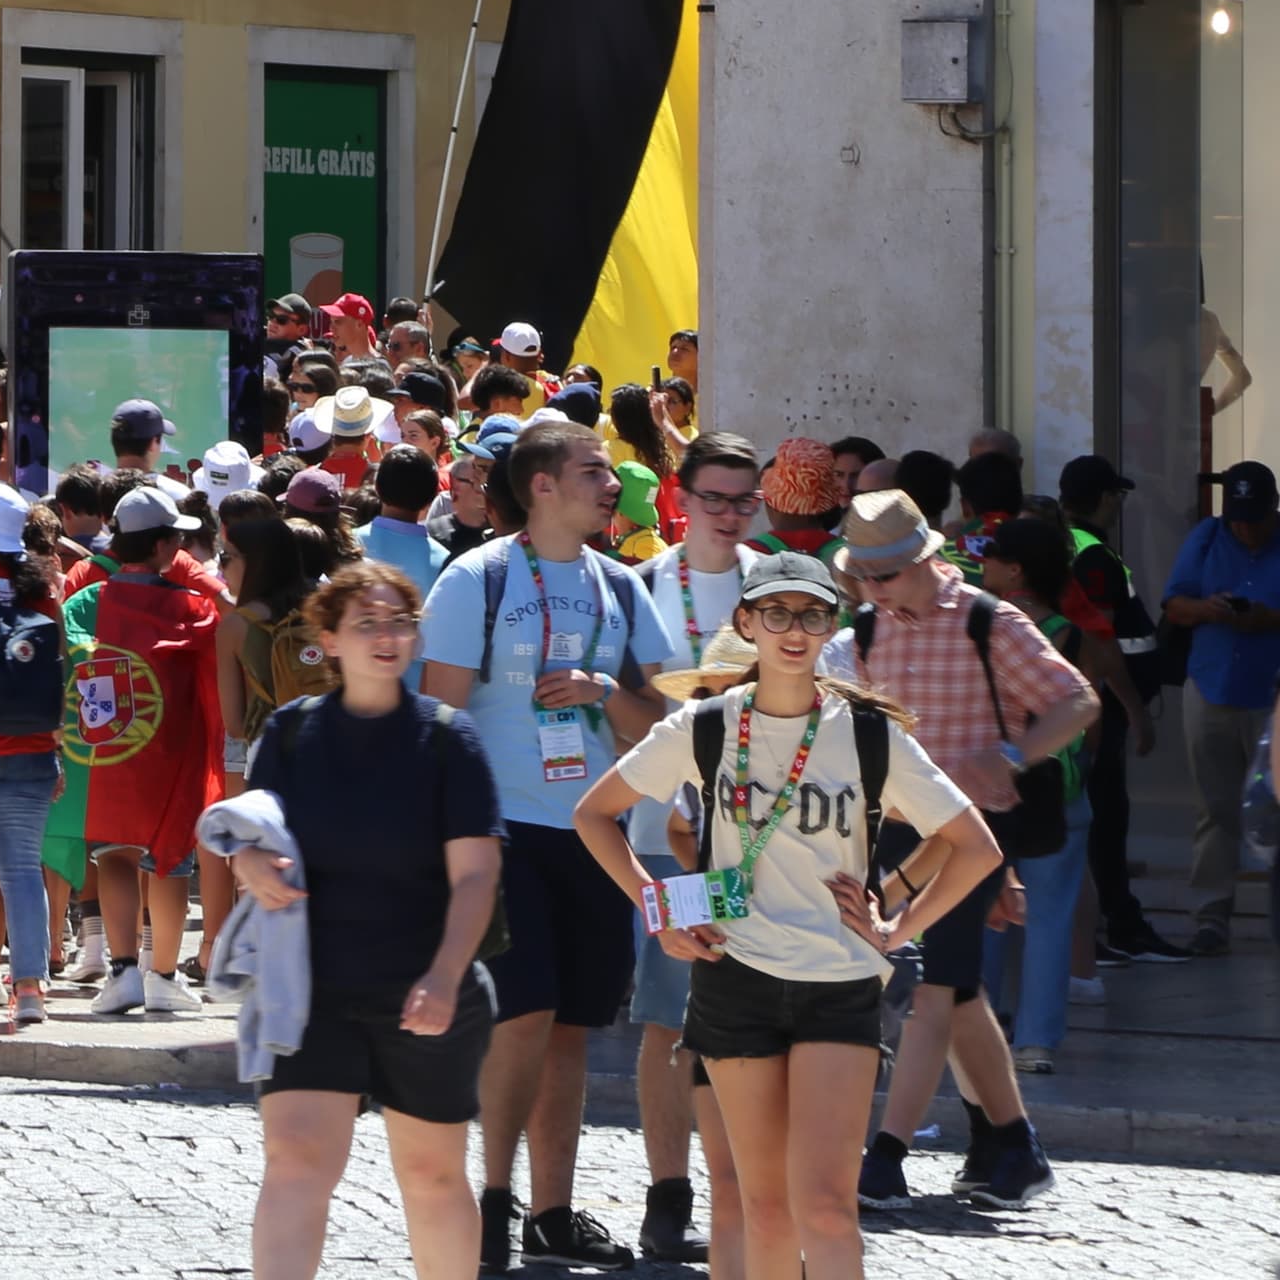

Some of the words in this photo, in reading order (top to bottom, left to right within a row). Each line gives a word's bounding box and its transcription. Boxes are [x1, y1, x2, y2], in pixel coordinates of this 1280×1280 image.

[263, 146, 315, 175] REFILL
[317, 141, 376, 178] GRÁTIS
[712, 895, 727, 919] A25
